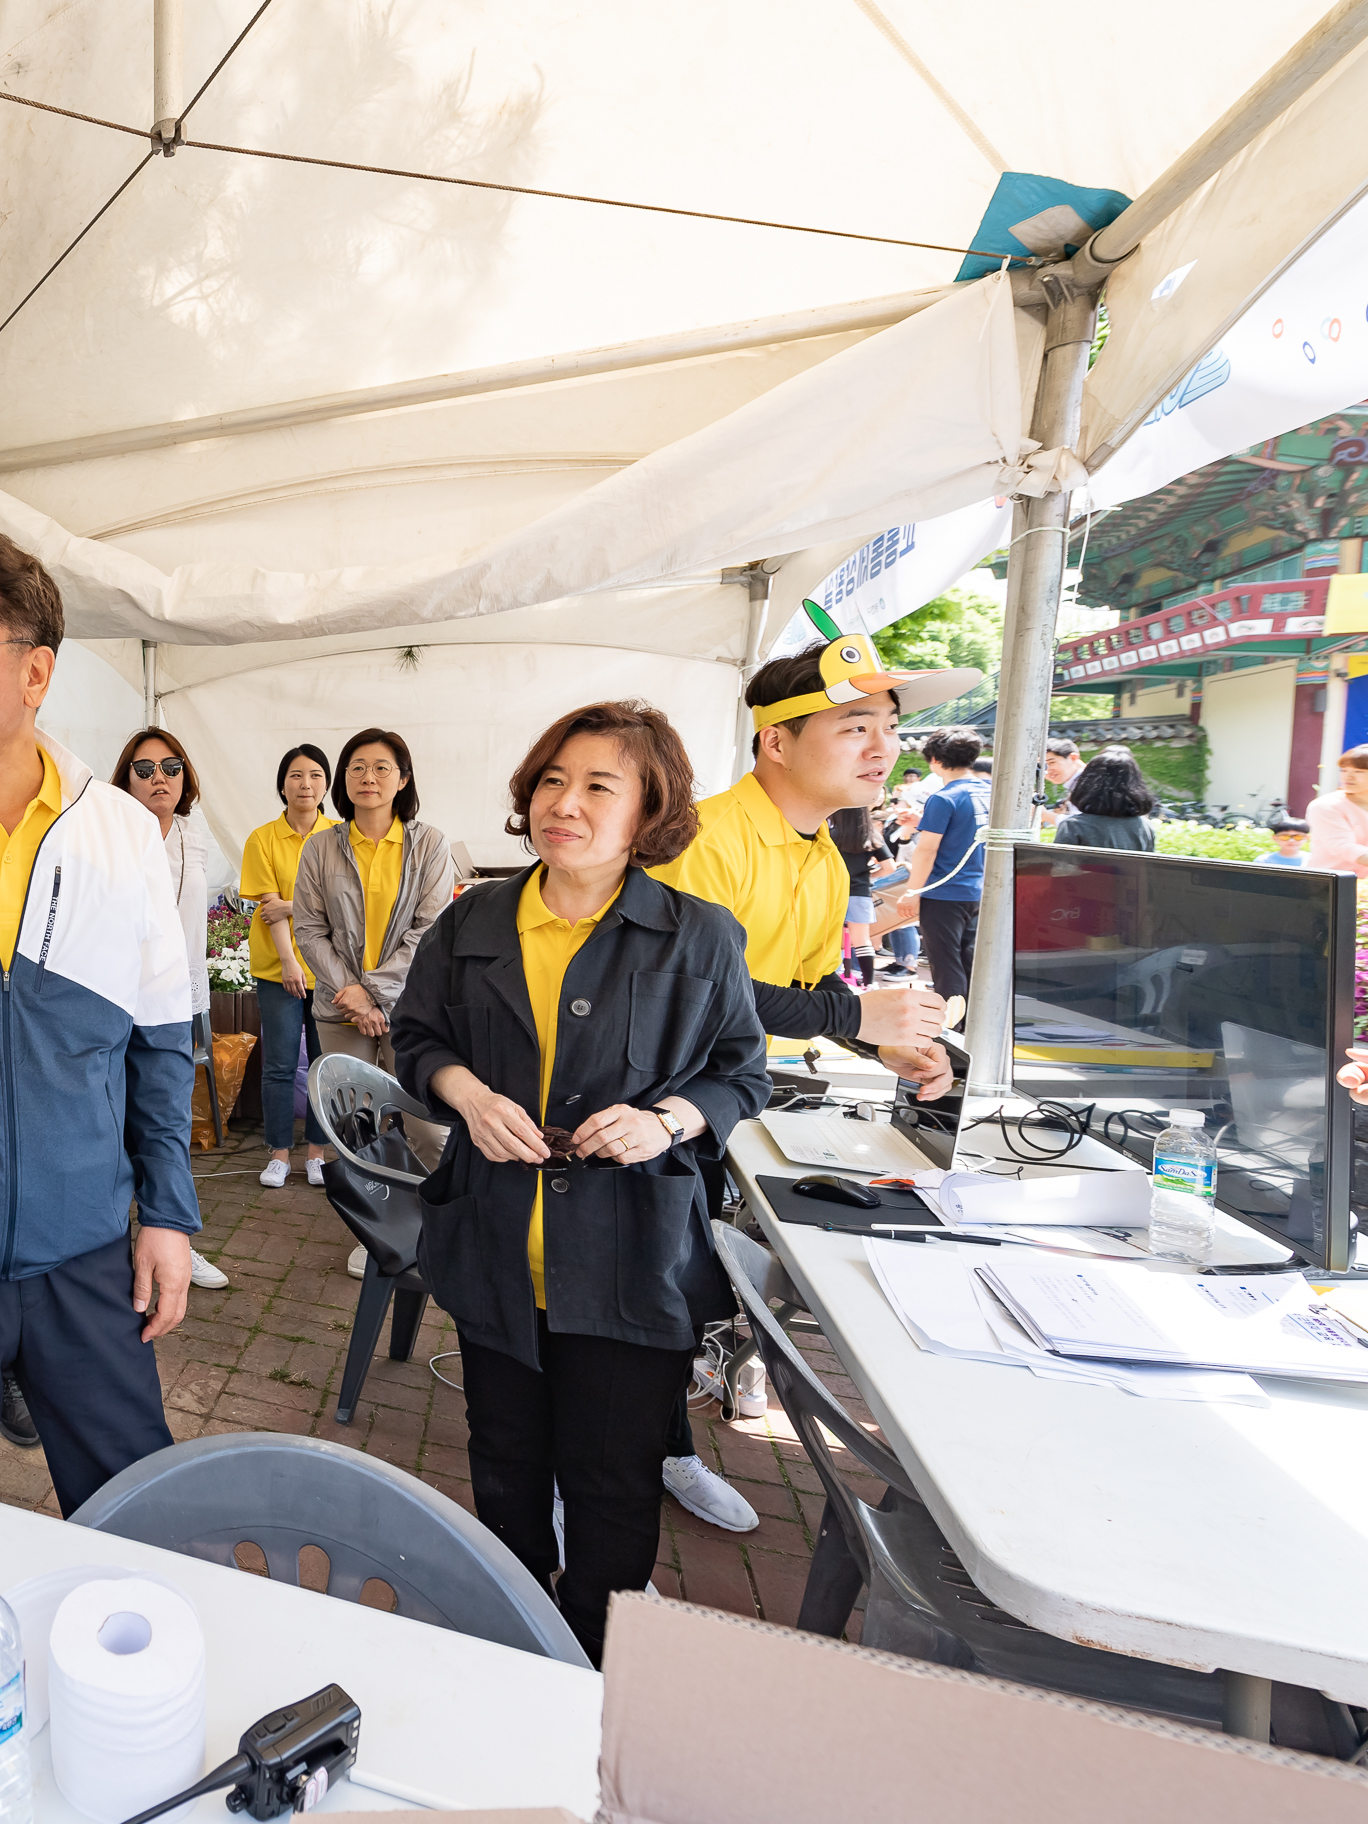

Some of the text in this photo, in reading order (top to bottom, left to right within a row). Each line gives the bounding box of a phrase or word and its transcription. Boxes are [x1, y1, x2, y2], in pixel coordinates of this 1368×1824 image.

[39, 896, 58, 962] THE NORTH FACE
